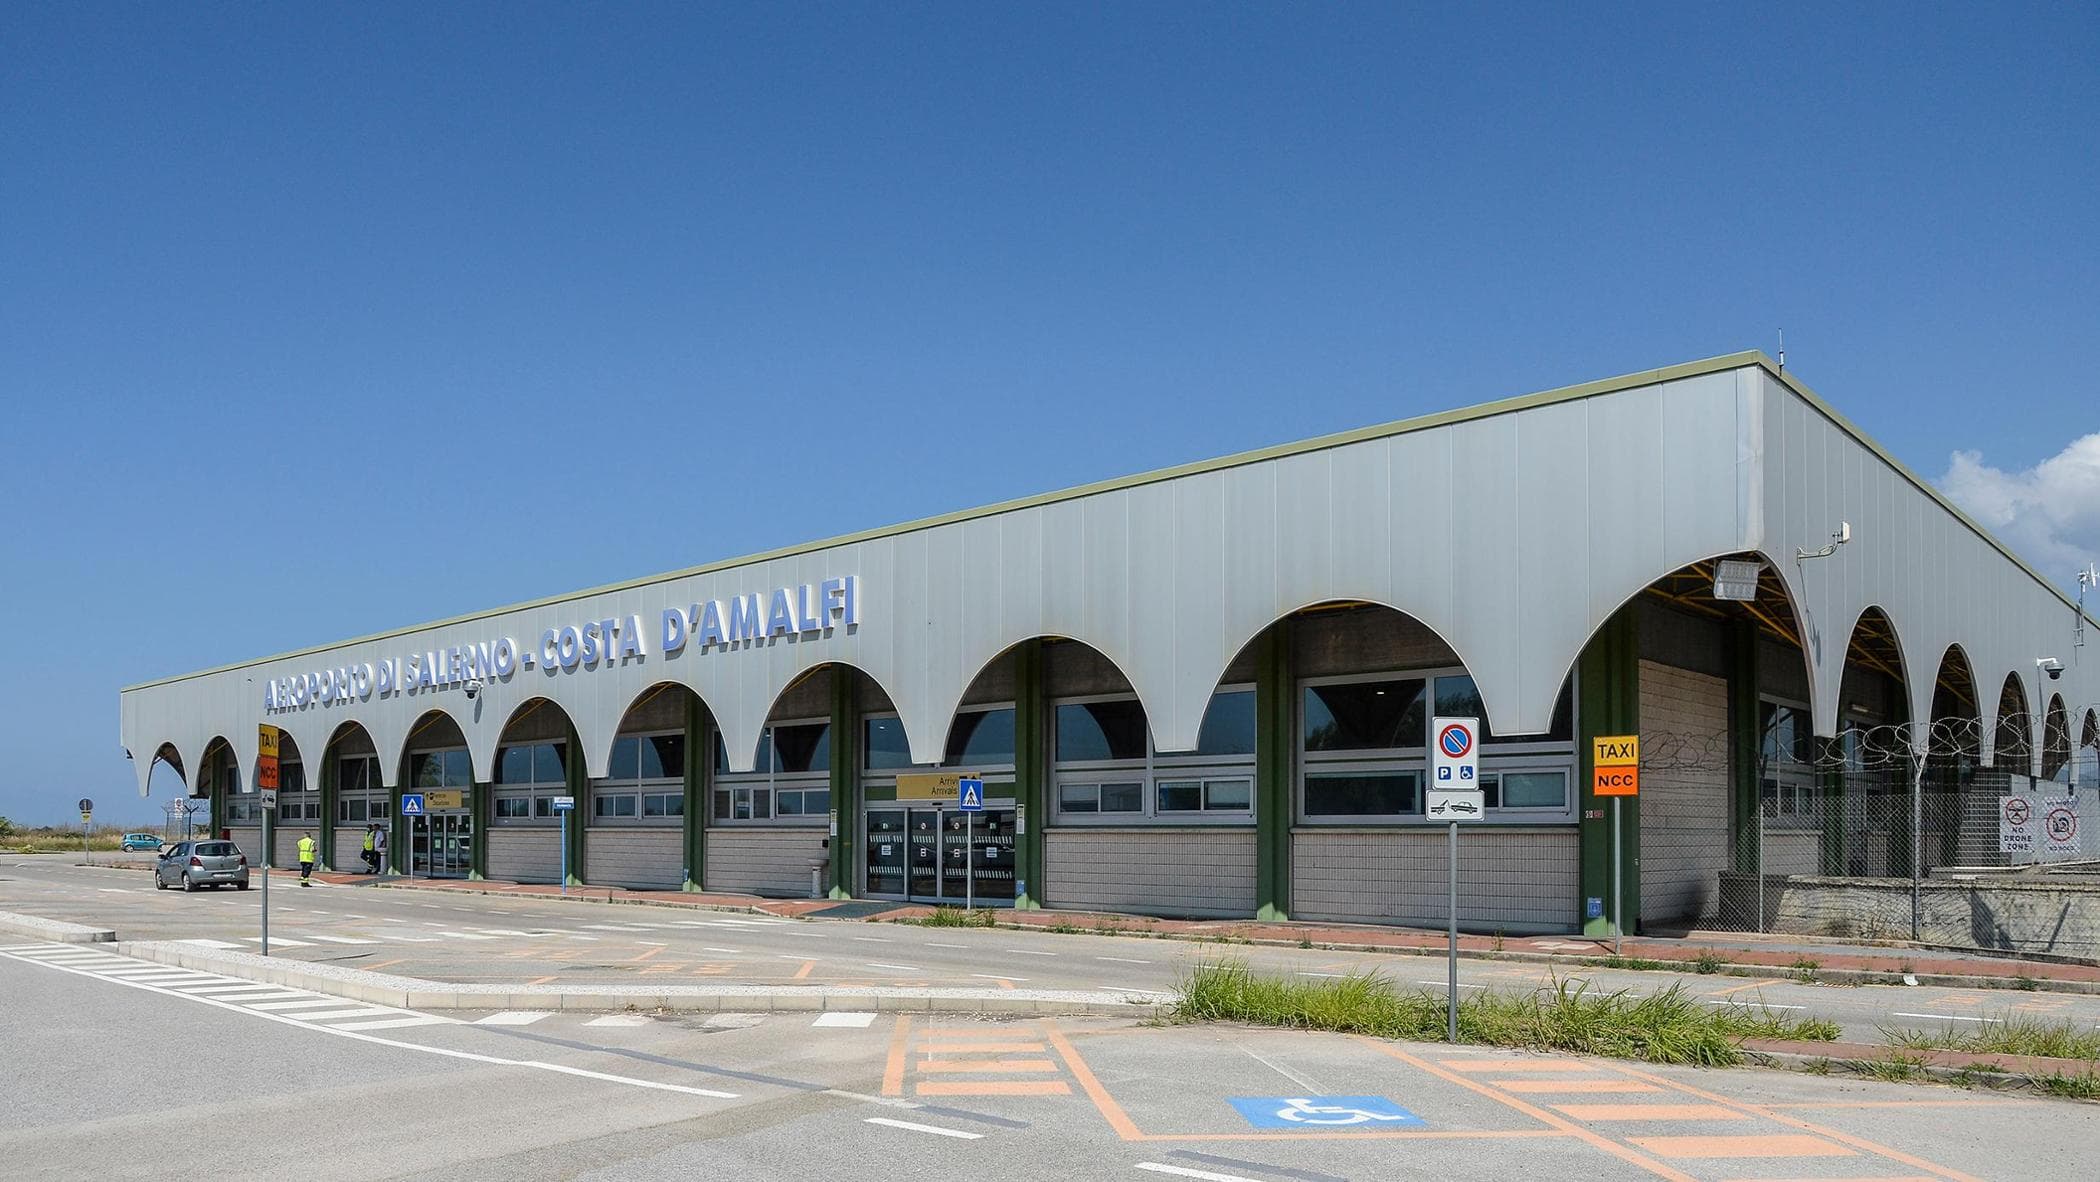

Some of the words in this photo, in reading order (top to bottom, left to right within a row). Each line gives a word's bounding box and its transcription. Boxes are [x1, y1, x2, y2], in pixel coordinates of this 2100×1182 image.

[264, 663, 373, 709] AEROPORTO
[376, 656, 401, 696] DI
[405, 636, 517, 691] SALERNO
[539, 614, 646, 670] COSTA
[662, 575, 859, 651] D'AMALFI
[260, 733, 277, 747] TAXI
[1597, 743, 1635, 759] TAXI
[260, 766, 276, 779] NCC
[1598, 774, 1634, 787] NCC
[931, 787, 958, 796] Arrivals
